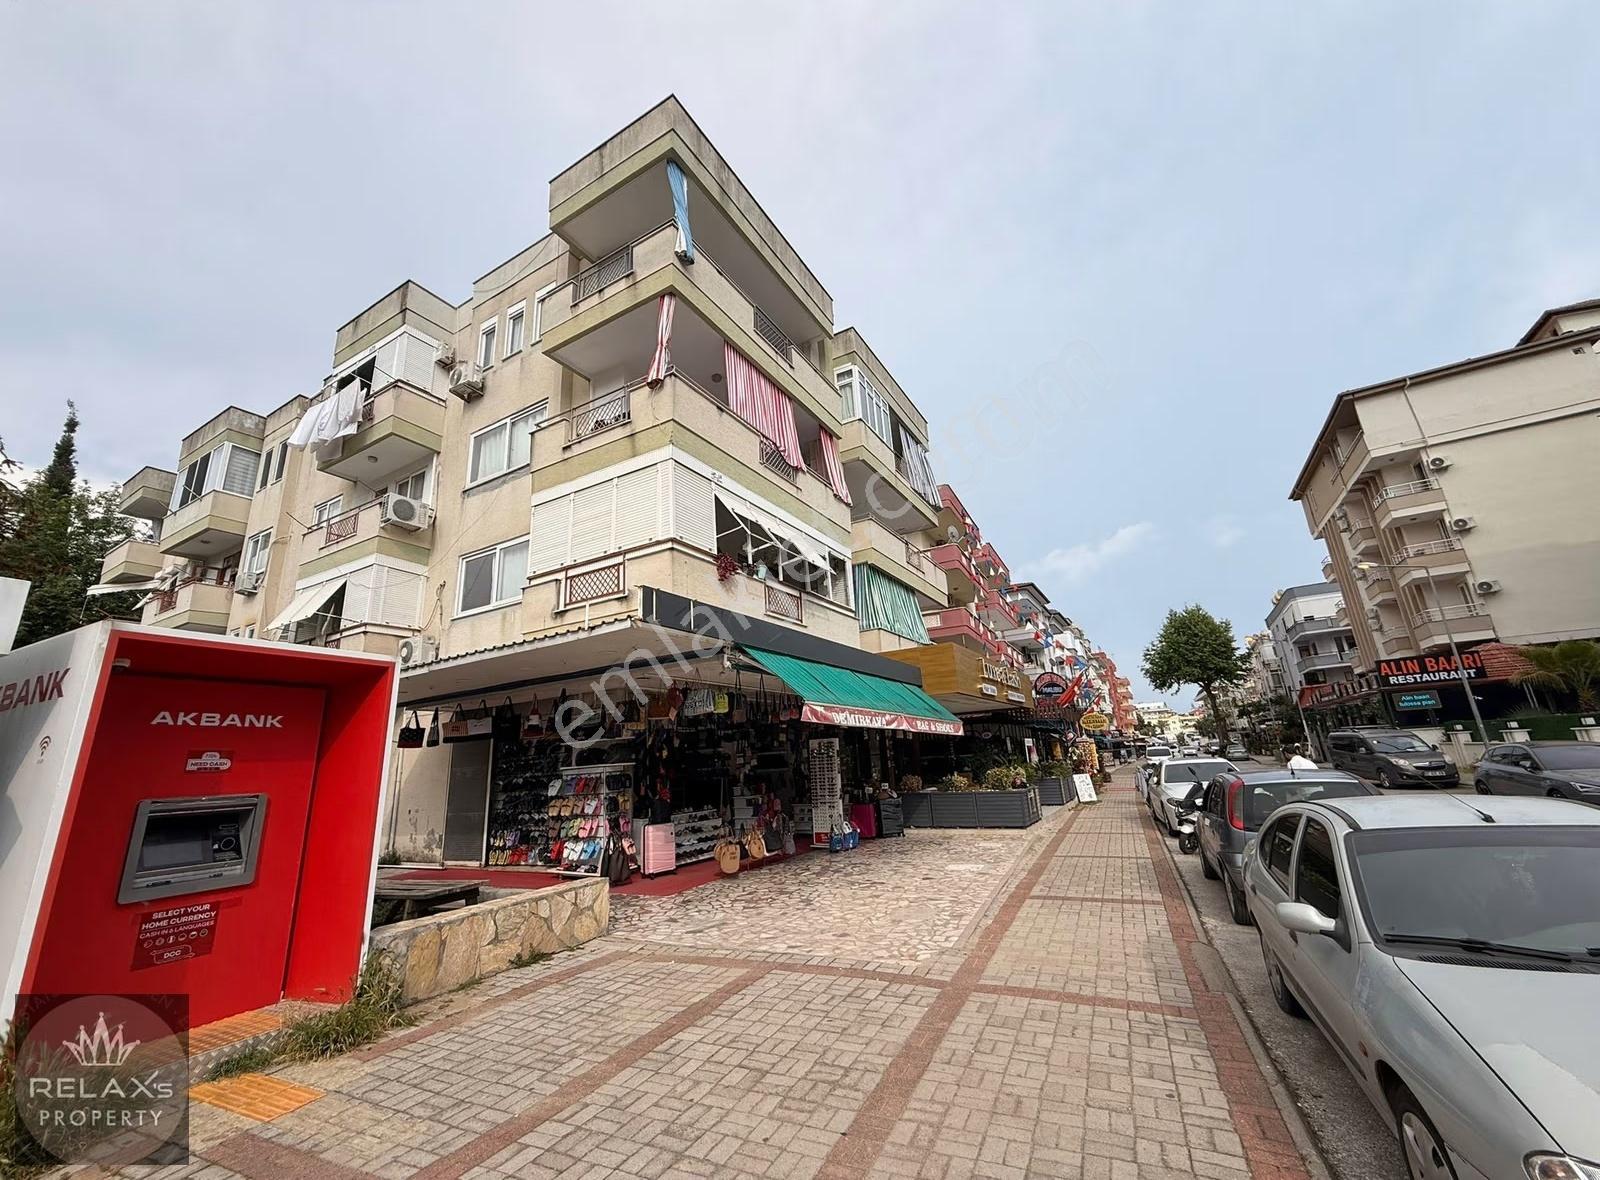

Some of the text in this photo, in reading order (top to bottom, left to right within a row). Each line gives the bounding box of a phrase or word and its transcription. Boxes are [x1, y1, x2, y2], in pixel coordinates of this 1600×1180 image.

[1380, 653, 1482, 676] ALIN BAARI
[1388, 669, 1477, 685] RESTAURANT
[0, 667, 71, 712] BANK
[150, 711, 284, 728] AKBANK
[141, 910, 217, 930] HOME CURRENCY
[152, 903, 211, 920] SELECT YOUR
[139, 929, 160, 940] CASH
[160, 927, 168, 936] IN
[174, 919, 215, 933] LANGUAGES
[163, 949, 182, 959] DCC
